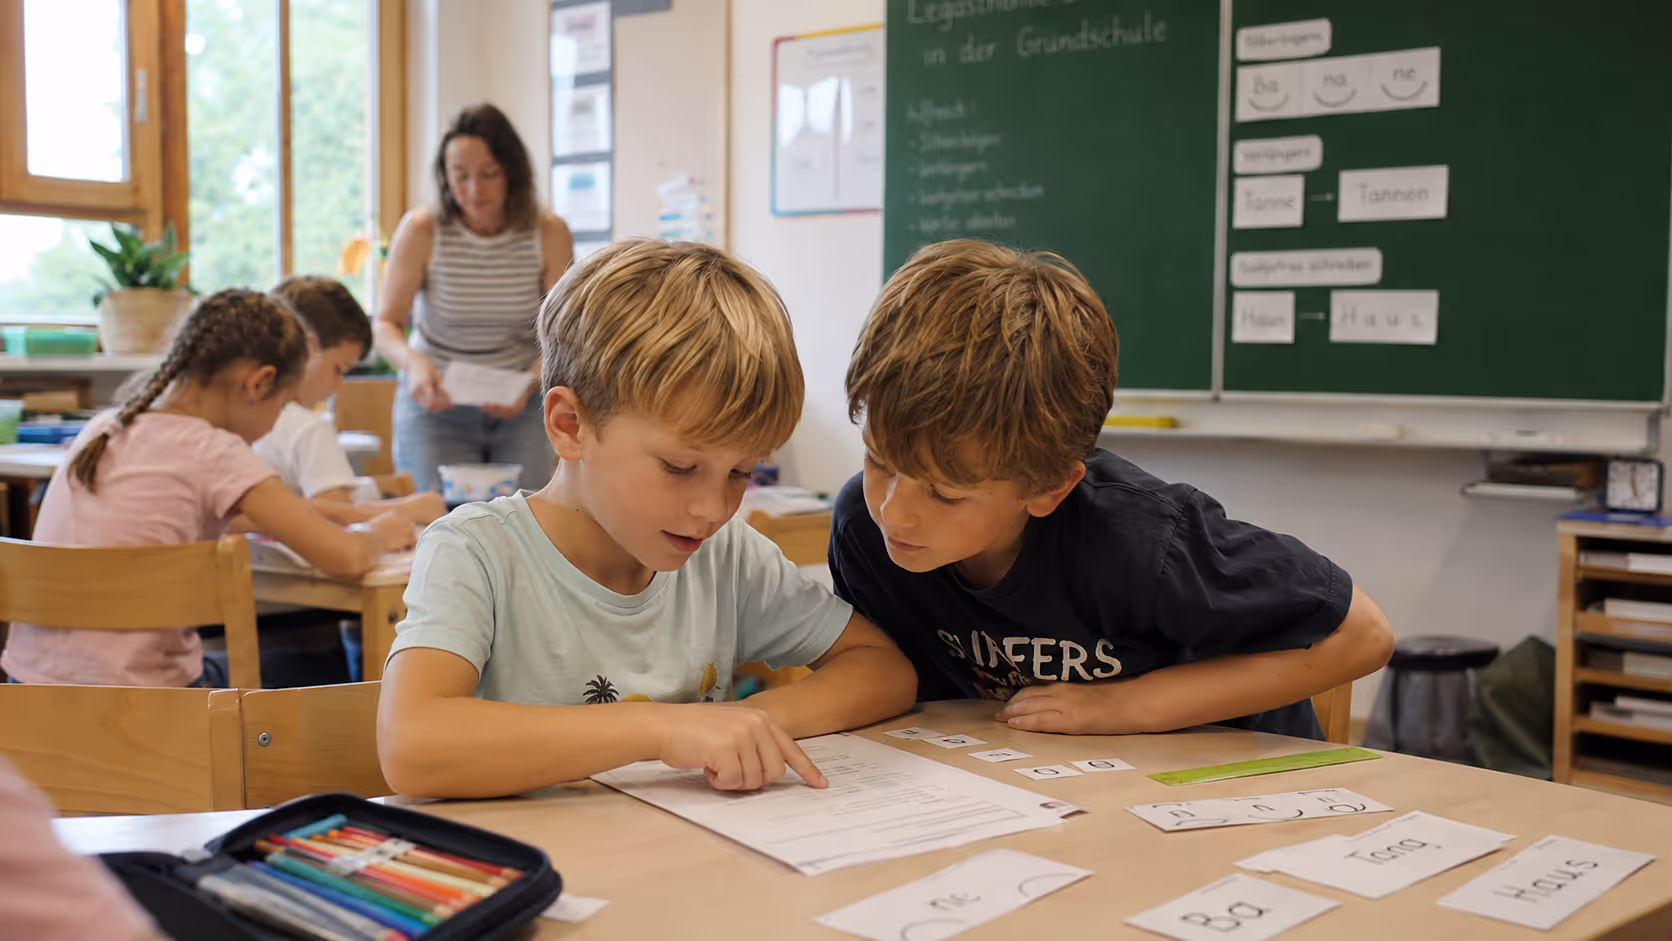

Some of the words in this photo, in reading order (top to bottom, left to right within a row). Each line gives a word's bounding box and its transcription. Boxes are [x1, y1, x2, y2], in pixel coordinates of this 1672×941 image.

[1016, 11, 1168, 58] Grundschule
[1358, 183, 1429, 204] Tannen
[1491, 860, 1599, 903] Haus
[1178, 901, 1273, 933] Ba
